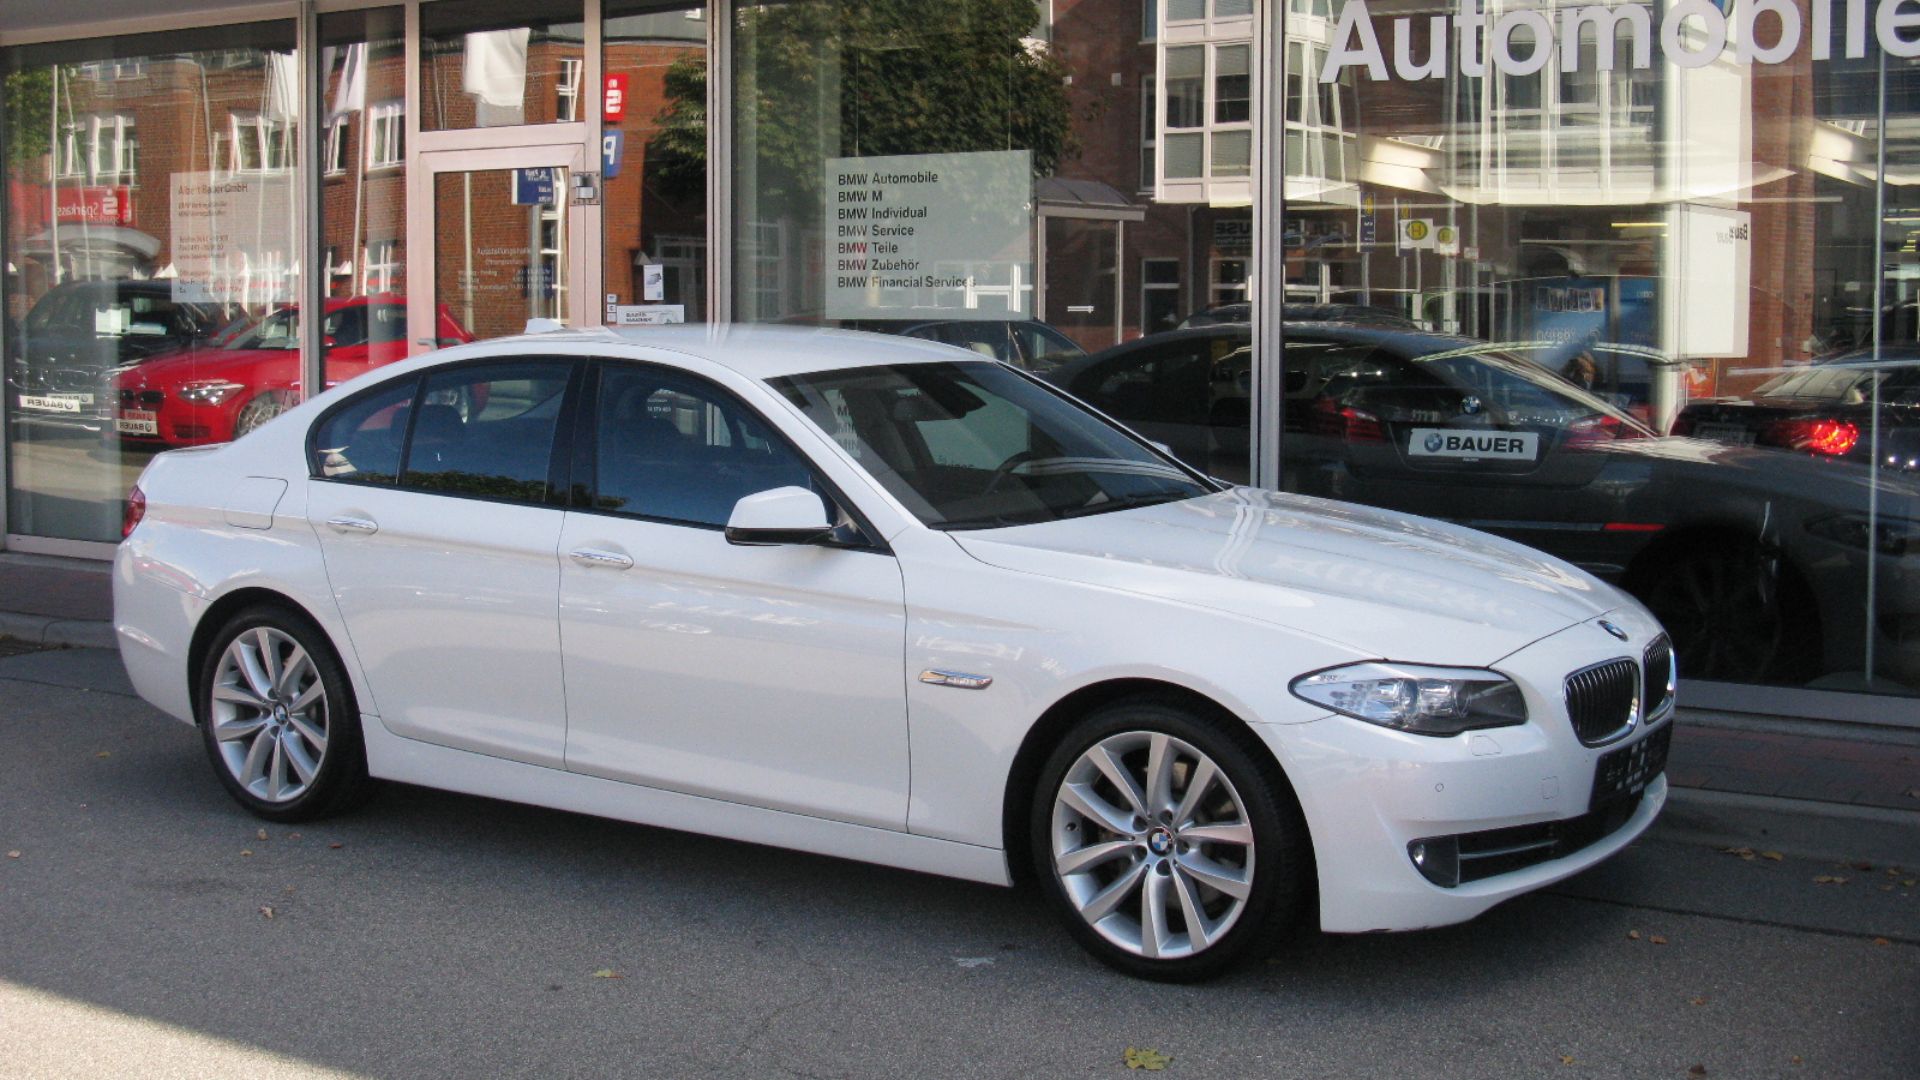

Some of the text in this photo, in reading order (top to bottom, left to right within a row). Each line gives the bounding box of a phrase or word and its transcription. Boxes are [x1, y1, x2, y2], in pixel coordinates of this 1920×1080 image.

[838, 171, 938, 186] BMW Automobile
[838, 190, 883, 202] BMW M
[838, 206, 928, 219] BMW Individual
[838, 224, 914, 237] BMW Service
[838, 242, 898, 254] BMW Teile
[838, 258, 919, 271] BMW Zubehör
[838, 275, 976, 288] BMW Financial Services
[1446, 436, 1525, 453] BAUER
